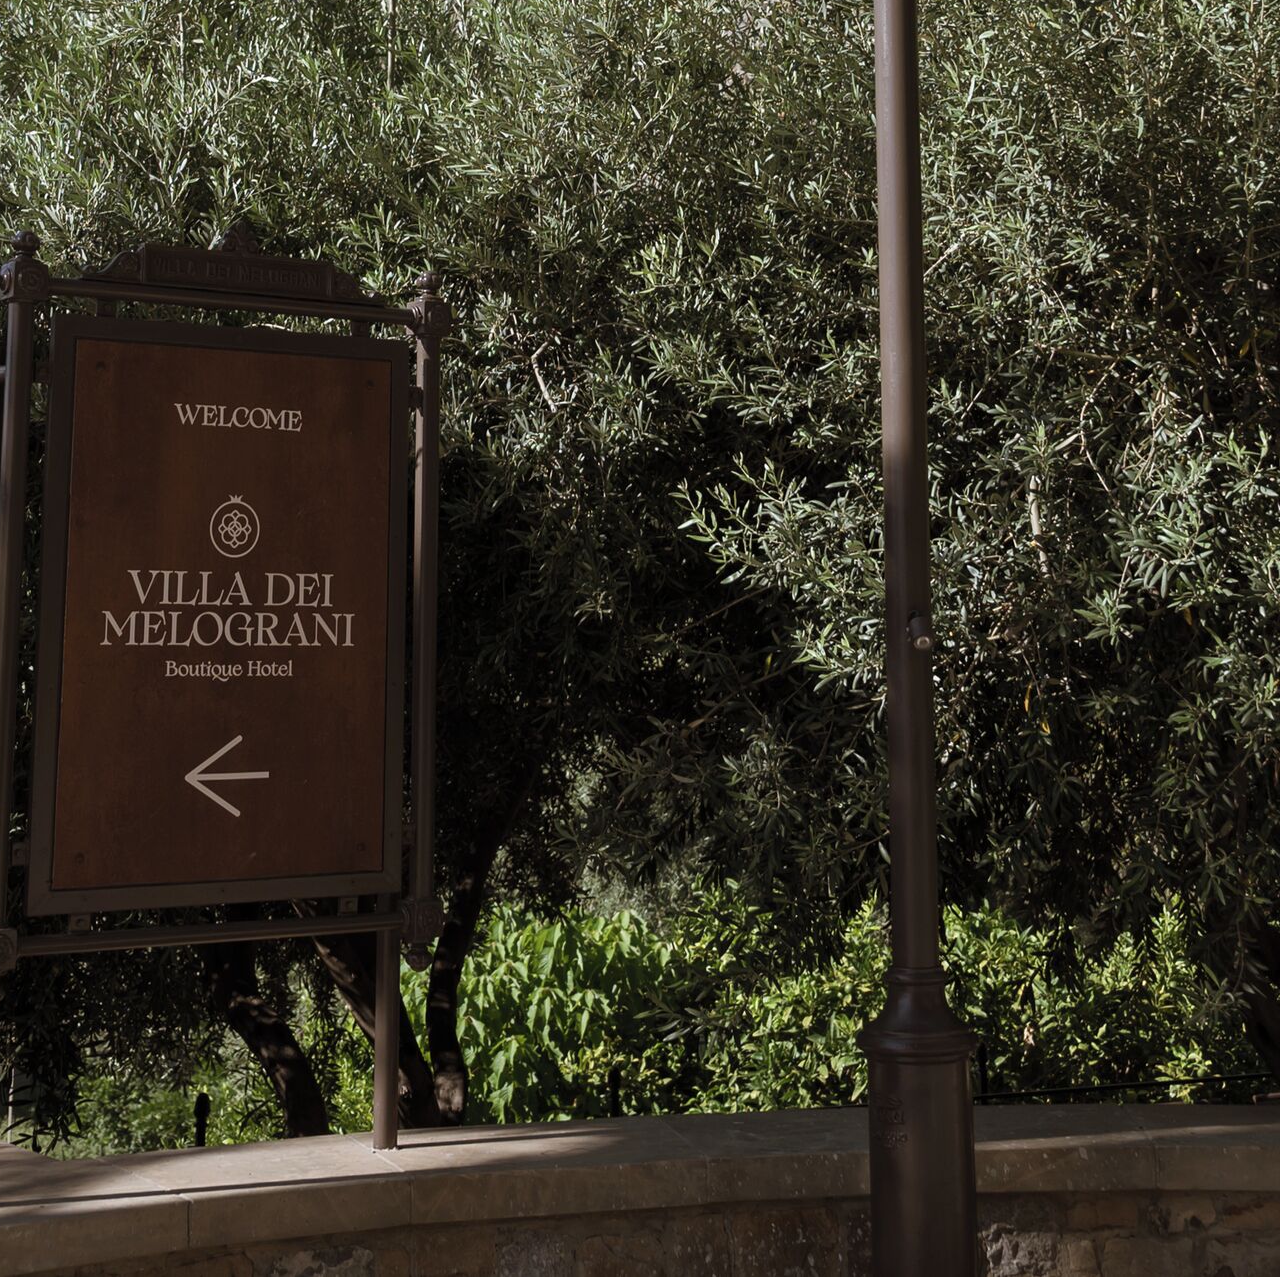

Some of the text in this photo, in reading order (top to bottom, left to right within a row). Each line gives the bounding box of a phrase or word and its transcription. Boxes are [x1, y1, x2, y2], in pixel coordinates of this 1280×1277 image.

[153, 258, 196, 277] VILLA
[174, 403, 302, 432] WELCOME
[127, 570, 334, 607] VILLA DEI
[100, 610, 355, 647] MELOGRANI
[165, 660, 292, 682] Boutique Hotel
